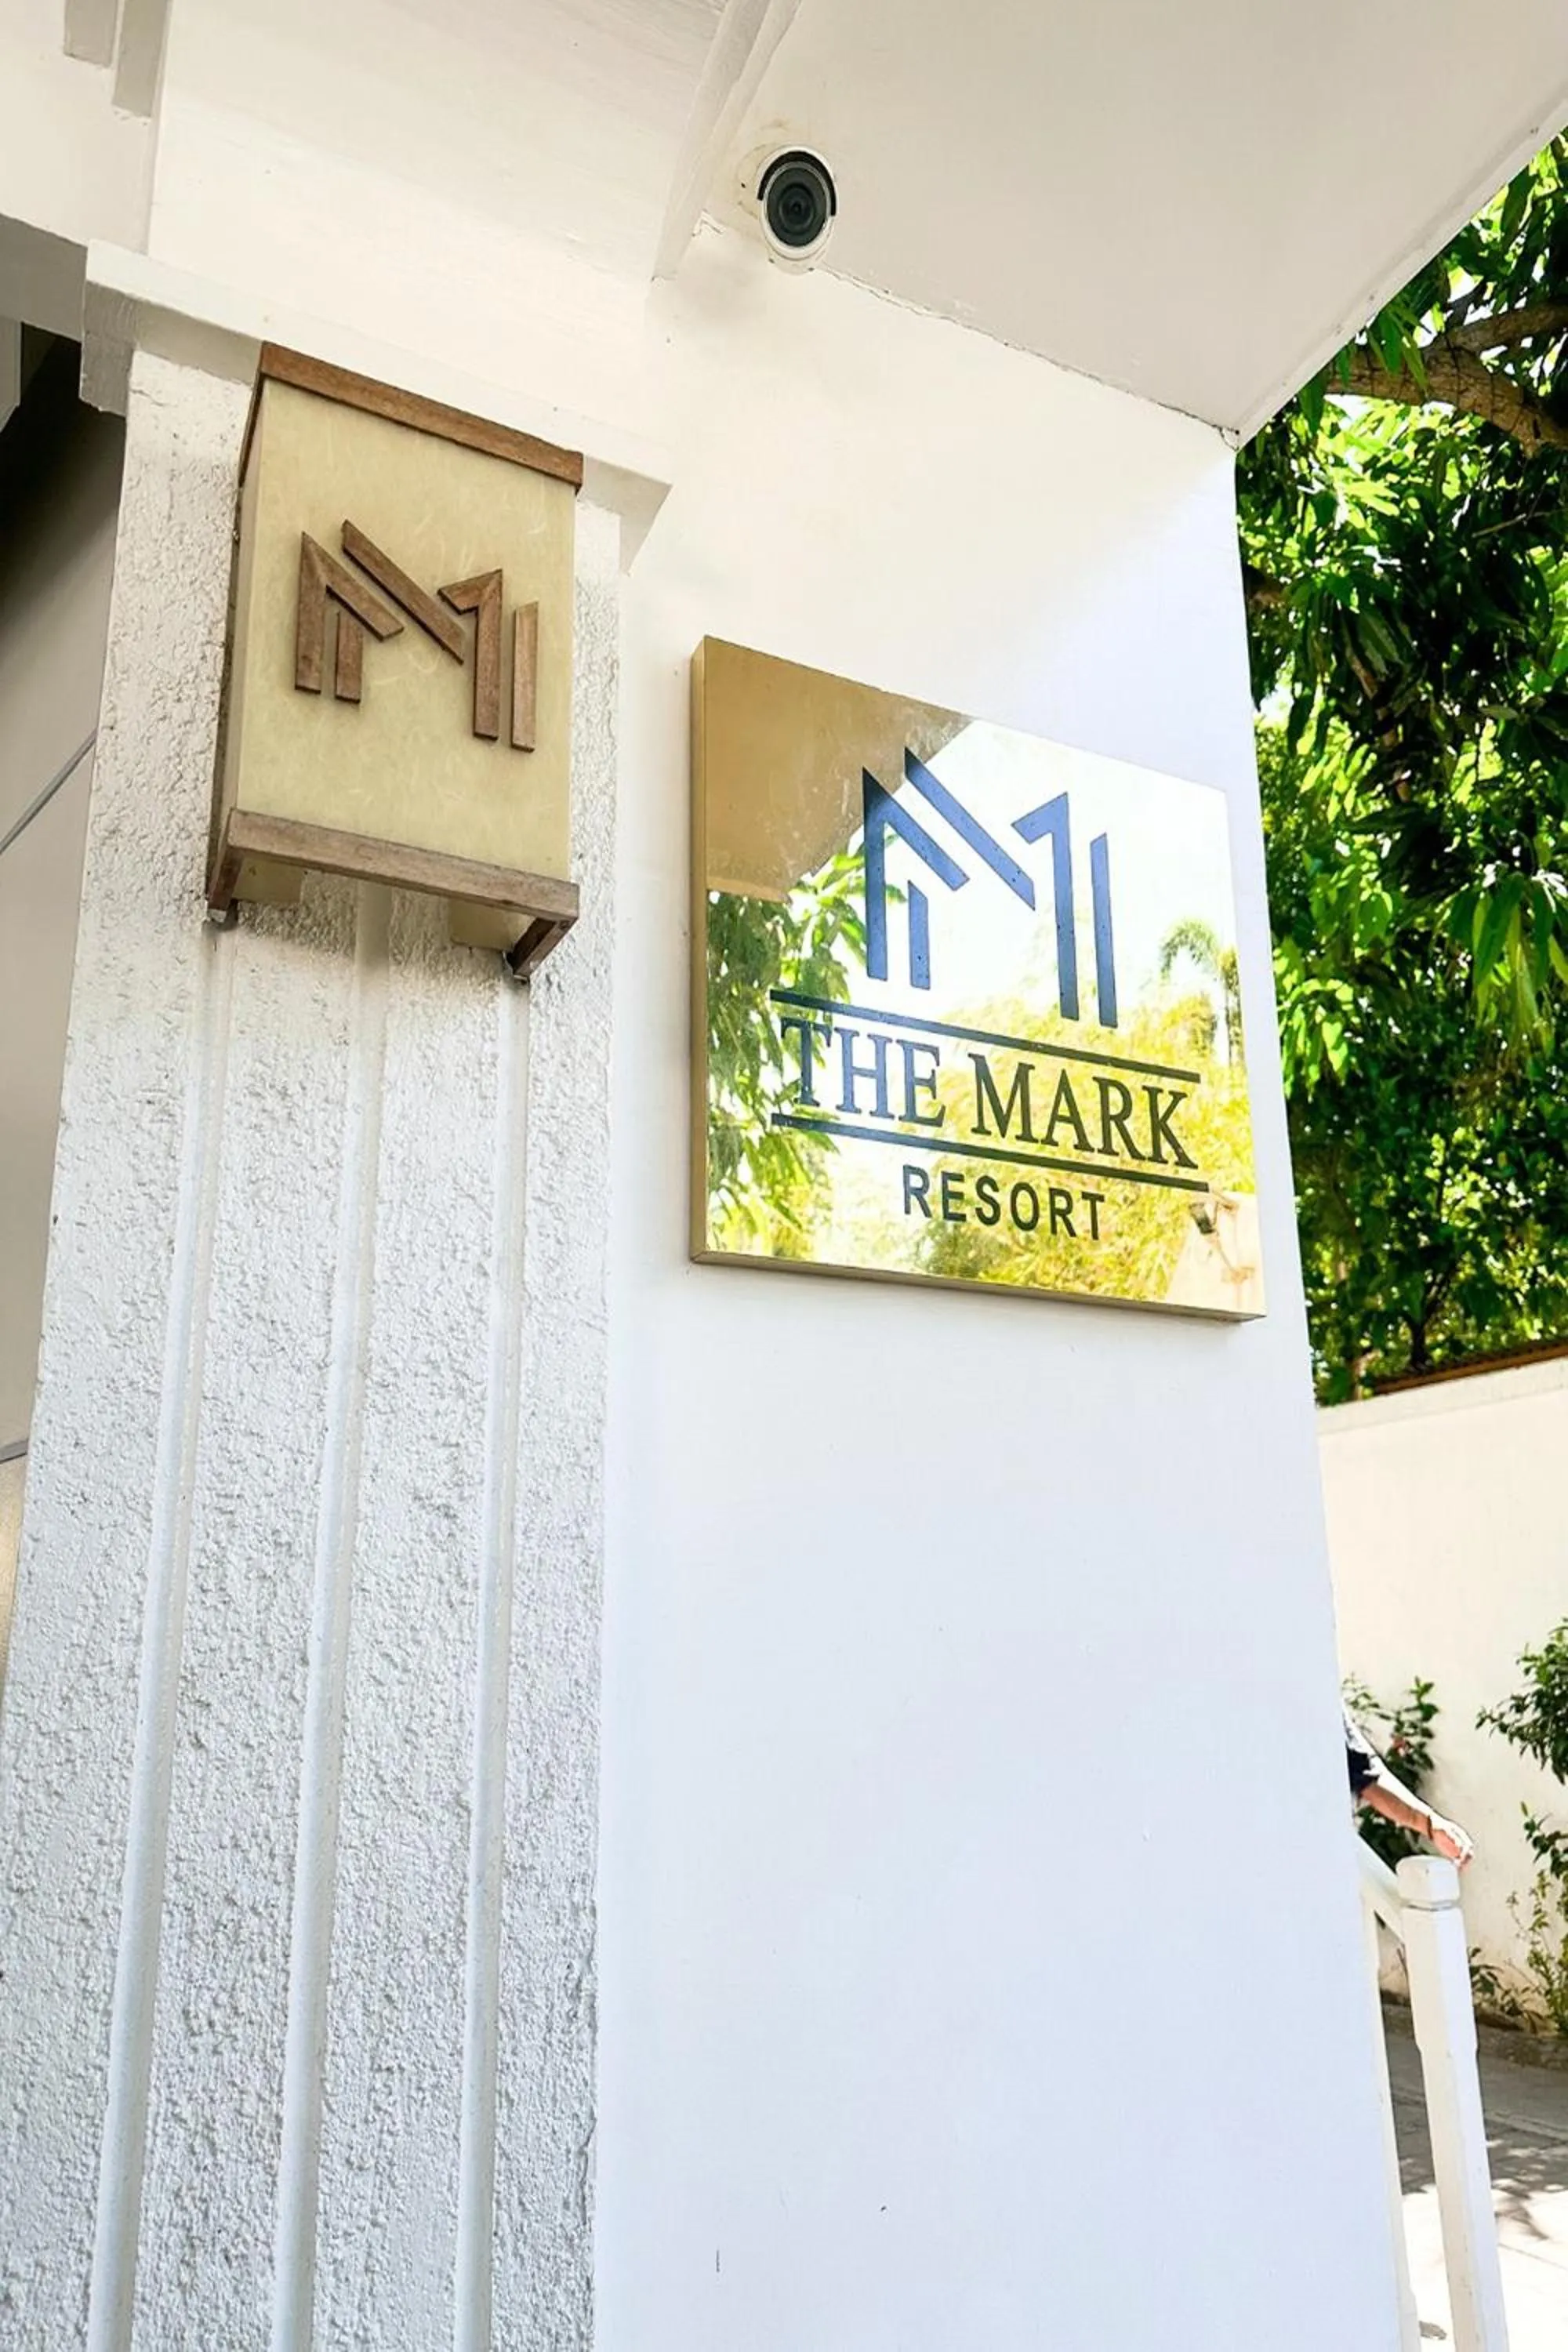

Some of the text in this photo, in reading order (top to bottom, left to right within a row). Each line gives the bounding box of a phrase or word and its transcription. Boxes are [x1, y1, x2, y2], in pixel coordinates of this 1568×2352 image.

[781, 1016, 1200, 1171] THE MARK
[902, 1163, 1106, 1242] RESORT
